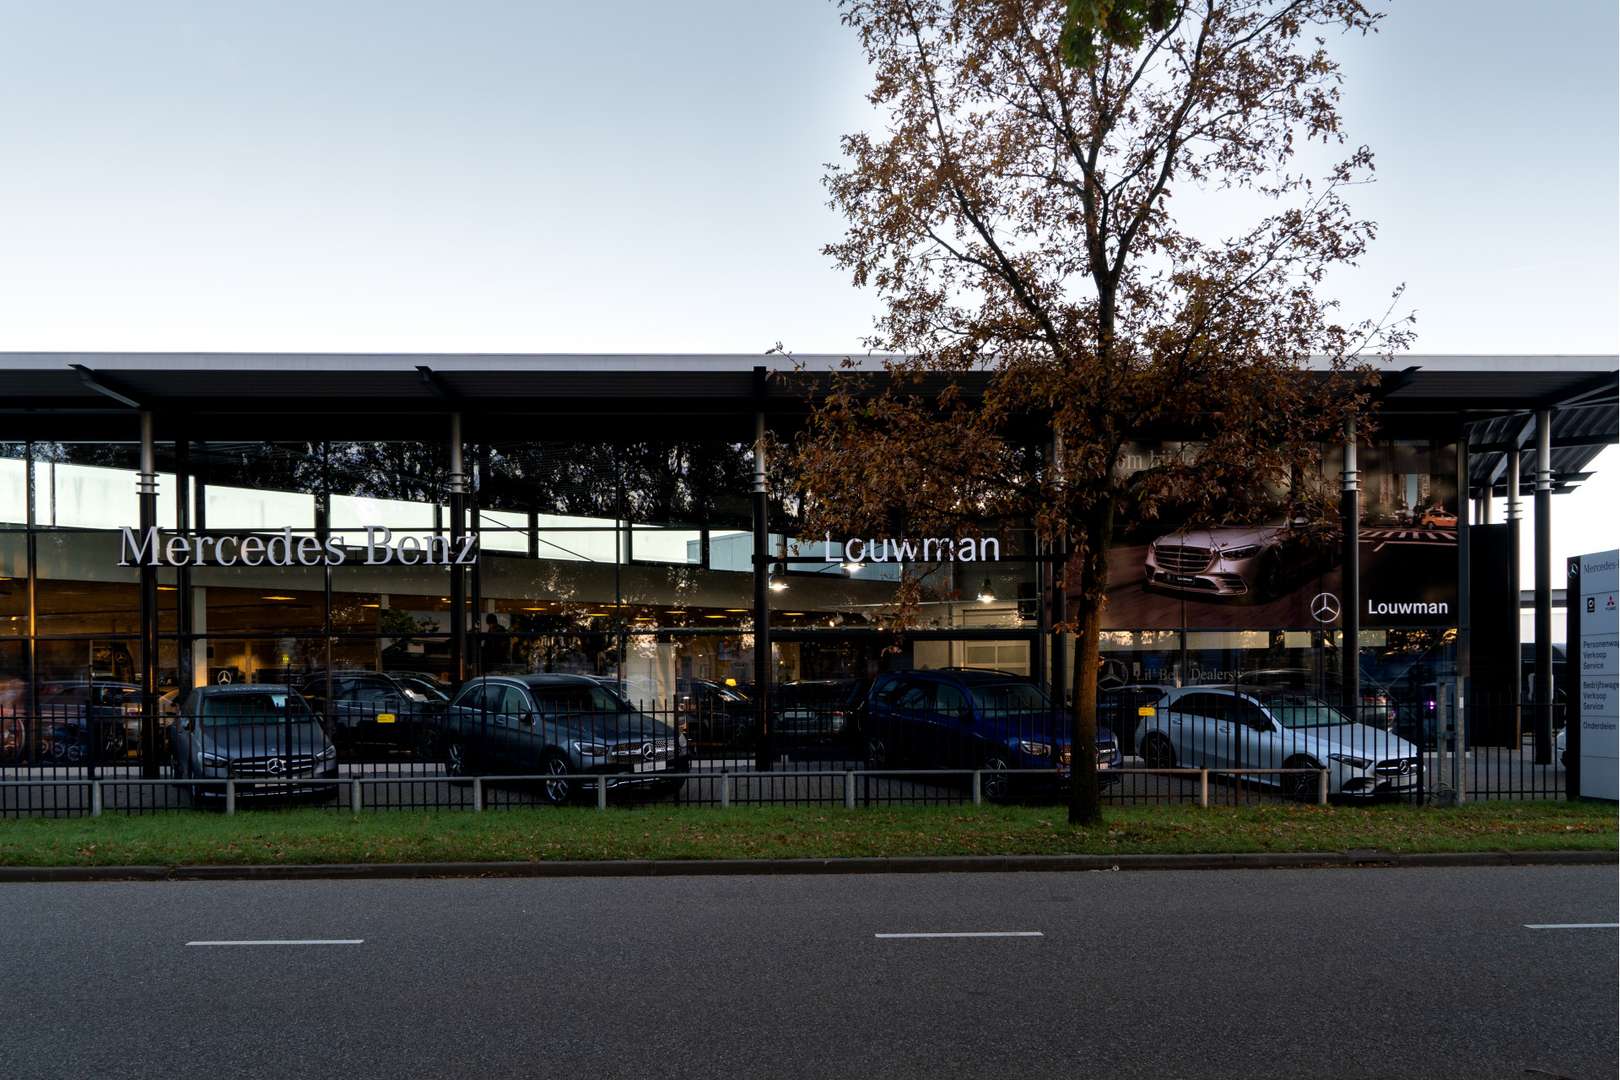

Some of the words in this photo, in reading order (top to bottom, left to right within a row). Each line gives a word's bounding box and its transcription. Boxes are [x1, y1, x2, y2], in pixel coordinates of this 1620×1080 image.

[117, 525, 479, 567] Mercedes-Benz
[824, 531, 1000, 563] Louwman
[1368, 599, 1448, 615] Louwman
[1583, 651, 1607, 660] Verkoop
[1583, 662, 1604, 670] Service
[1583, 693, 1607, 702] Verkoop
[1583, 703, 1604, 711] Service
[1583, 721, 1616, 730] Onderdelen
